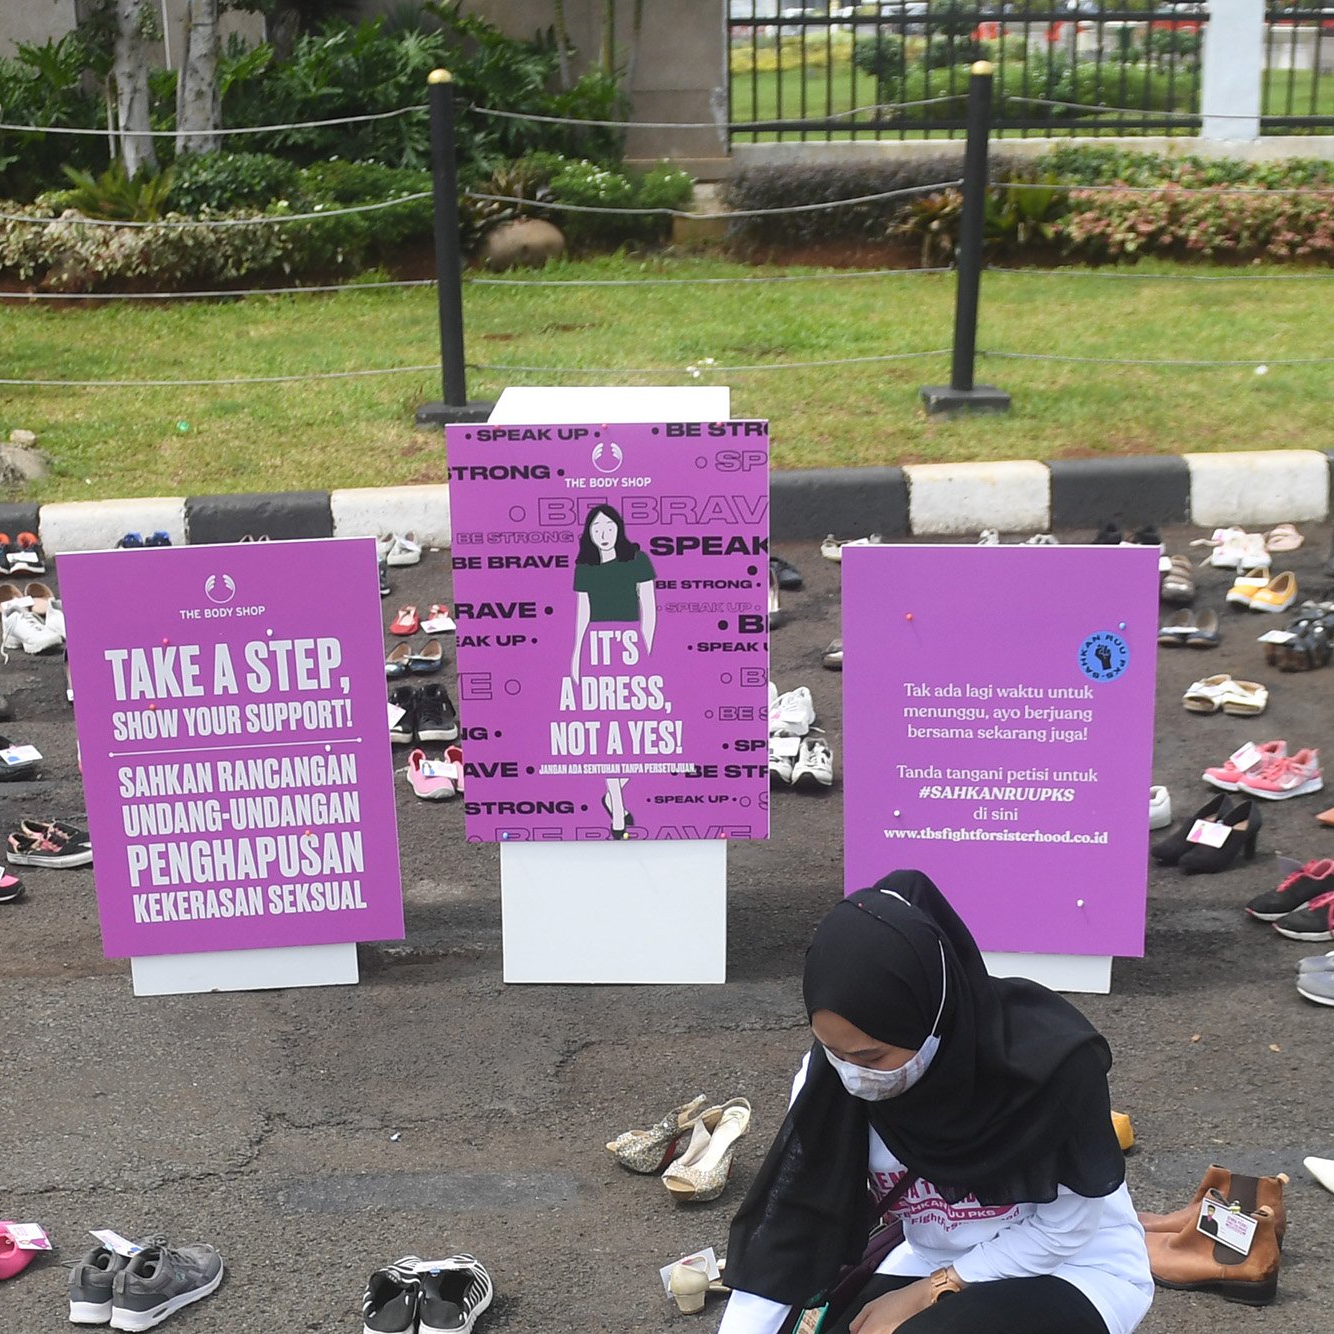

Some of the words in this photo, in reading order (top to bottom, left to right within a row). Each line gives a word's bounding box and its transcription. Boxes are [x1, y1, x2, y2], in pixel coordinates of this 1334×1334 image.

[476, 429, 552, 441] SPEAK
[557, 428, 589, 440] UP
[666, 423, 702, 437] BE
[447, 465, 551, 481] TRONG
[564, 478, 587, 488] THE
[589, 477, 619, 488] BODY
[621, 477, 652, 487] SHOP
[456, 532, 484, 545] BE
[487, 531, 574, 545] STRONG
[452, 556, 482, 570] BE
[487, 555, 569, 569] BRAVE
[655, 580, 678, 590] BE
[680, 580, 753, 589] STRONG
[179, 610, 201, 619] THE
[204, 608, 233, 618] BODY
[235, 606, 266, 616] SHOP
[665, 603, 726, 613] SPEAK
[728, 602, 753, 612] UP
[738, 614, 768, 634] B
[496, 635, 526, 647] UP
[590, 629, 640, 666] IT'S
[697, 642, 759, 652] SPEAK
[104, 645, 205, 702] TAKE
[213, 643, 239, 696] A
[244, 637, 350, 695] STEP,
[740, 667, 768, 687] B
[458, 672, 493, 700] E
[903, 683, 931, 698] Tak
[934, 683, 962, 698] ada
[966, 683, 993, 700] lagi
[996, 684, 1044, 699] waktu
[1047, 684, 1094, 699] untuk
[559, 676, 577, 711] A
[581, 675, 672, 714] DRESS,
[111, 709, 179, 741] SHOW
[183, 704, 241, 737] YOUR
[244, 698, 353, 733] SUPPORT!
[718, 706, 754, 720] BE
[903, 707, 990, 721] menunggu,
[993, 709, 1021, 721] ayo
[1024, 706, 1093, 723] berjuang
[550, 721, 603, 756] NOT
[606, 721, 626, 755] A
[627, 720, 684, 755] YES!
[907, 724, 974, 740] bersama
[977, 725, 1048, 742] sekarang
[1050, 727, 1088, 742] juga!
[734, 740, 768, 751] SP
[118, 762, 214, 799] SAHKAN
[217, 753, 358, 792] RANCANGAN
[539, 764, 567, 775] JANGAN
[568, 764, 582, 774] ADA
[583, 764, 620, 774] SENTUHAN
[621, 763, 643, 774] TANPA
[896, 765, 943, 780] Tanda
[946, 766, 1003, 782] tangani
[1007, 767, 1050, 783] petisi
[1053, 768, 1098, 782] untuk
[654, 795, 708, 804] SPEAK
[710, 795, 729, 803] UP
[918, 786, 1075, 802] #SAHKANRUUPKS
[122, 791, 361, 837] UNDANG-UNDANGAN
[465, 800, 574, 815] STRONG
[973, 807, 988, 820] di
[991, 807, 1018, 821] sini
[884, 827, 1108, 844] www.tbsfightforsisterhood.co.id
[126, 831, 365, 888] PENGHAPUSAN
[132, 886, 264, 923] KEKERASAN
[267, 880, 367, 915] SEKSUAL
[968, 1208, 996, 1218] PKS
